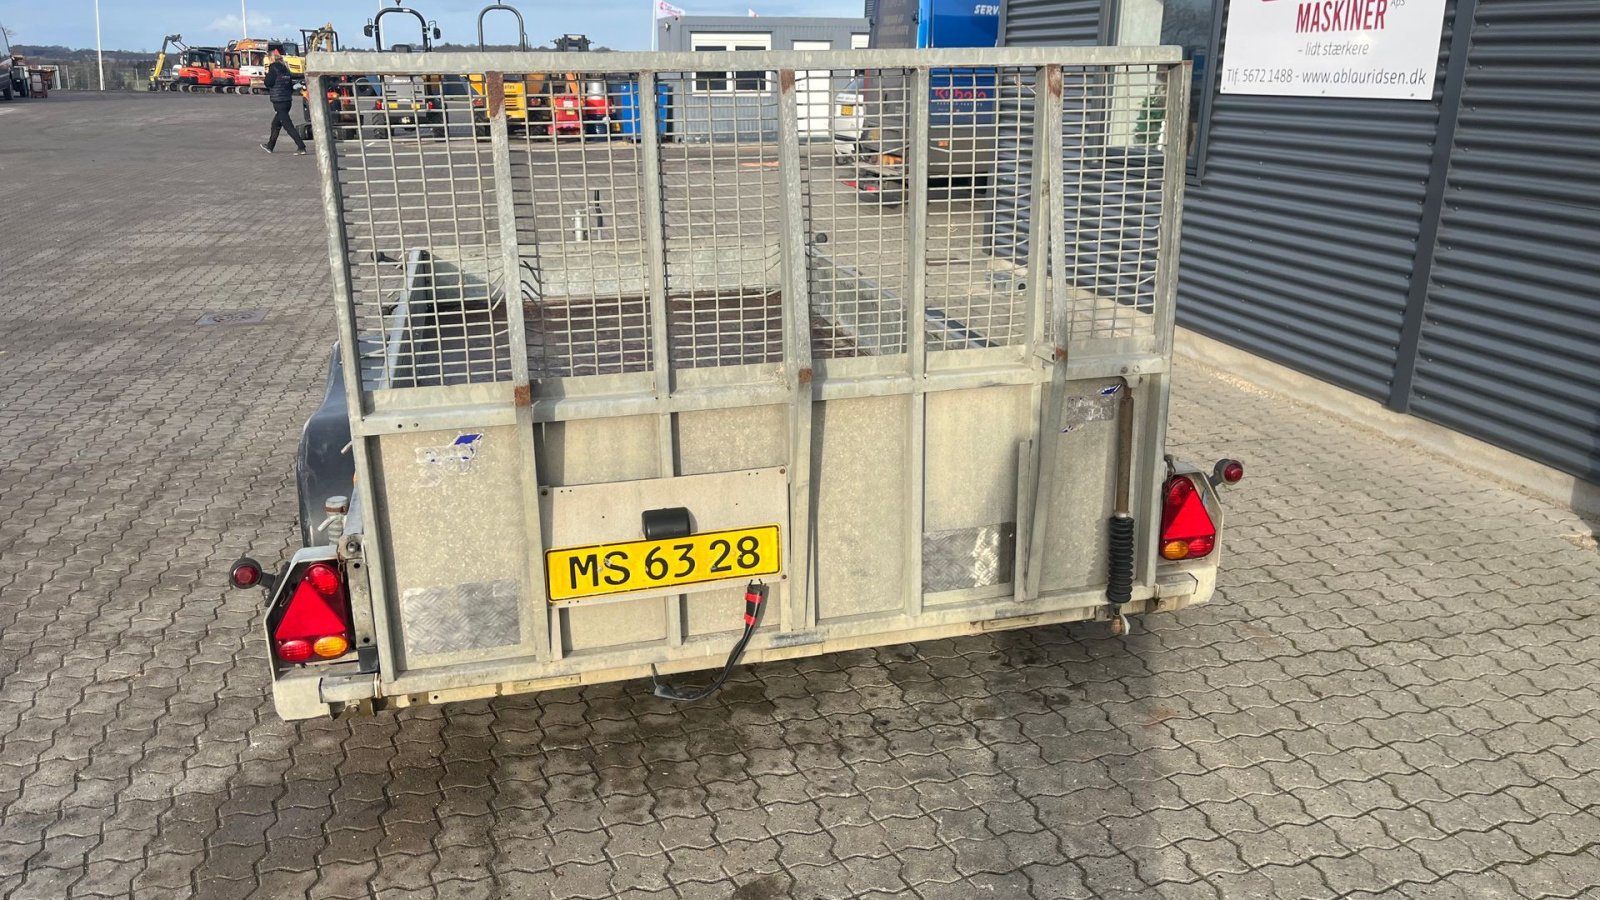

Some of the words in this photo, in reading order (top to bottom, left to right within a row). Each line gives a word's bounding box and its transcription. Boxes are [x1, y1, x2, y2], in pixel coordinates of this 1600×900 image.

[973, 4, 1000, 16] SERV
[1295, 0, 1388, 33] MASKINER
[1305, 41, 1321, 56] lidt
[1322, 41, 1370, 56] stærkere
[1227, 68, 1240, 86] Tlf.
[1242, 68, 1266, 83] 5672
[1267, 68, 1293, 83] 1488
[1302, 68, 1427, 85] www.ablauridsen.dk
[935, 88, 987, 101] Kboa
[568, 550, 631, 589] MS
[645, 543, 696, 581] 63
[709, 535, 761, 573] 28
